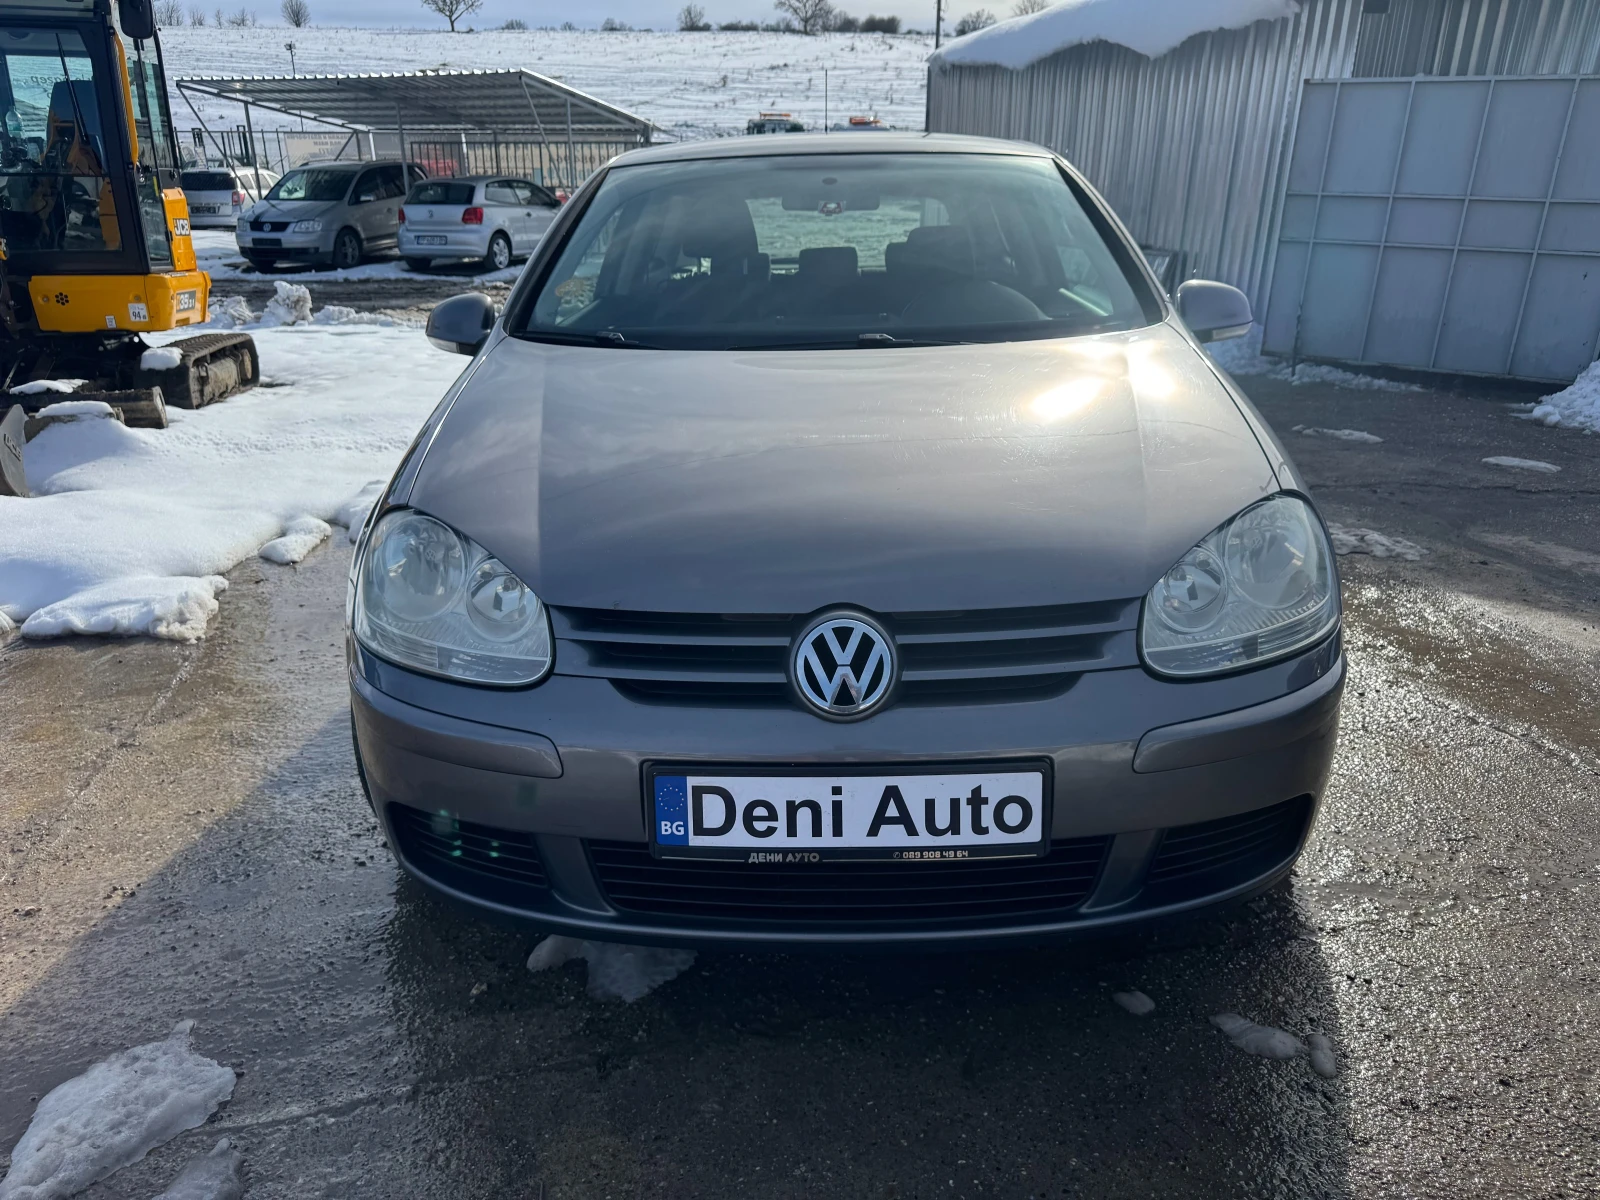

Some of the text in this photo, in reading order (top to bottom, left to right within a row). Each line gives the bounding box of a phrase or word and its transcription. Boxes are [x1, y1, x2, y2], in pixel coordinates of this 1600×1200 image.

[173, 219, 190, 236] JCB
[132, 311, 141, 320] 94
[797, 618, 891, 714] VW
[691, 784, 1033, 838] Deni Auto
[660, 821, 685, 835] BG
[748, 853, 819, 863] ДЕНИ АУТО
